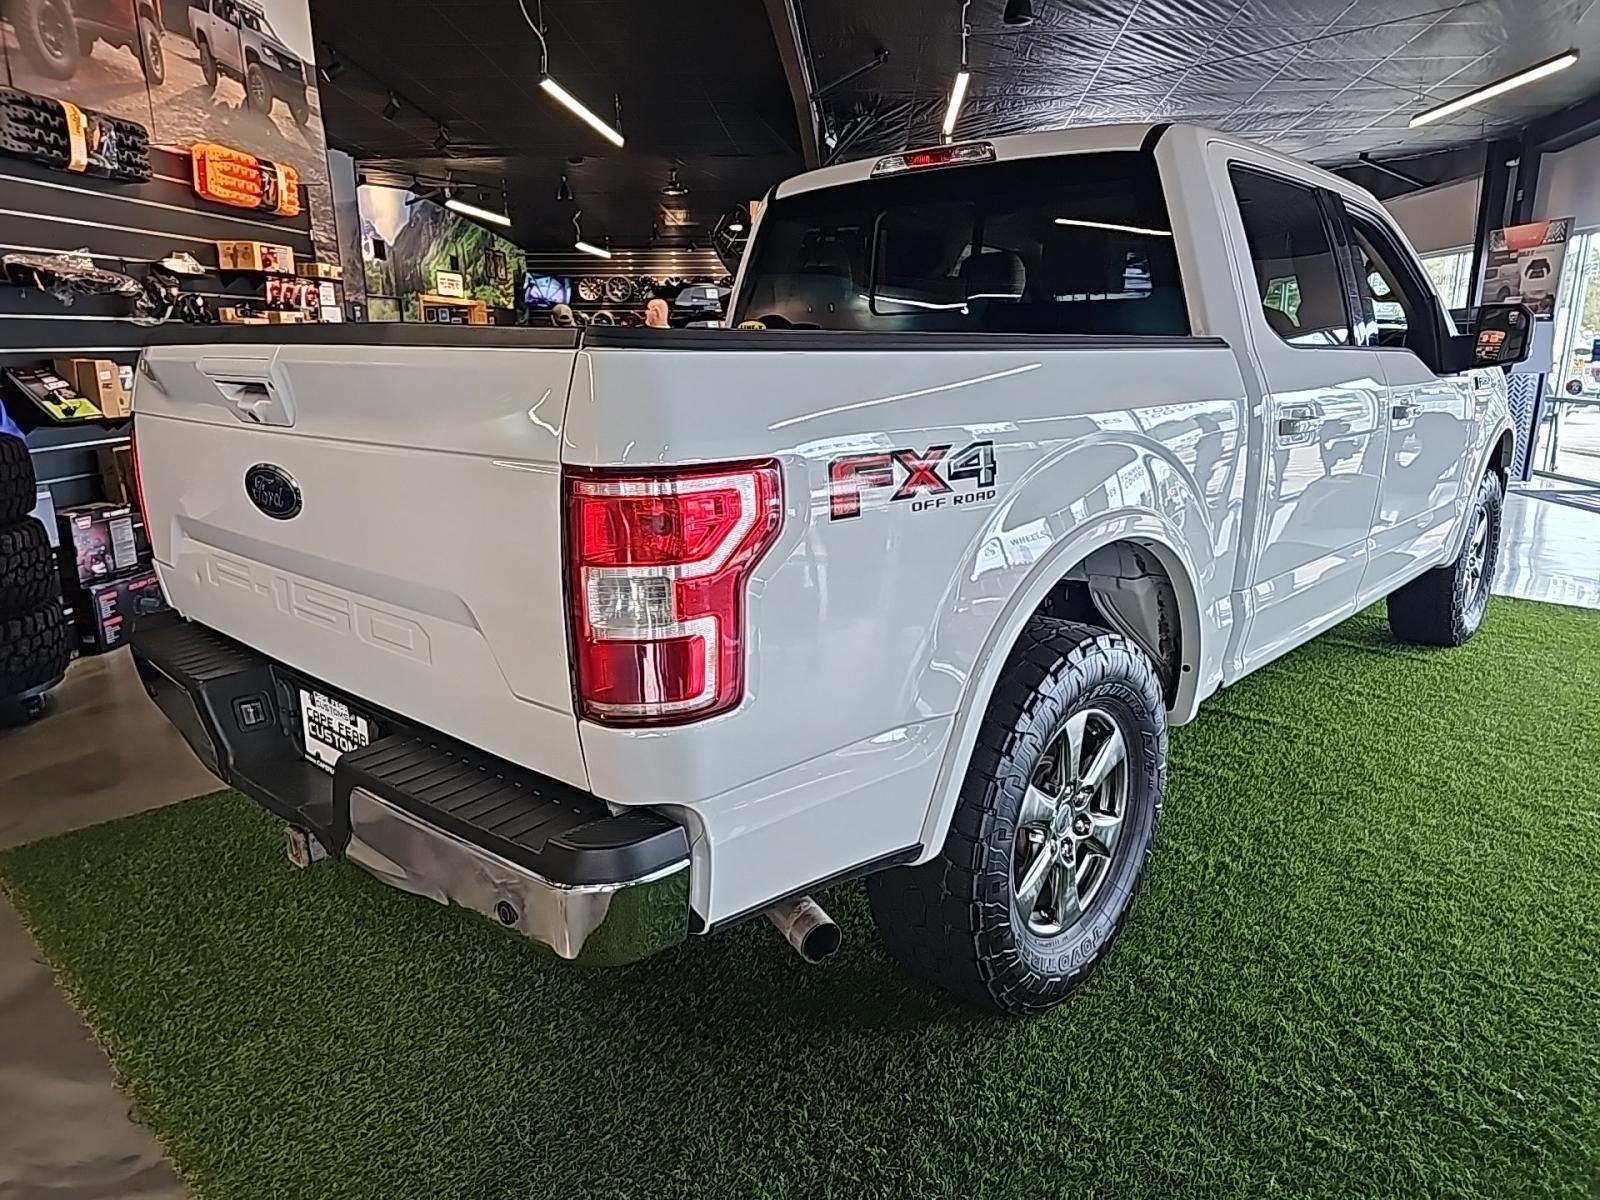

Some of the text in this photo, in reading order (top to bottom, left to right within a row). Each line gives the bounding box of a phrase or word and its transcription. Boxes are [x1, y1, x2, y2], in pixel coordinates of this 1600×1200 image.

[251, 474, 285, 508] Ford
[827, 440, 998, 522] FX4
[911, 489, 997, 512] OFF ROAD
[204, 553, 435, 668] F-150
[306, 706, 367, 746] CAPE FEAR
[308, 721, 359, 753] CUSTOM
[1058, 925, 1104, 973] TOYO
